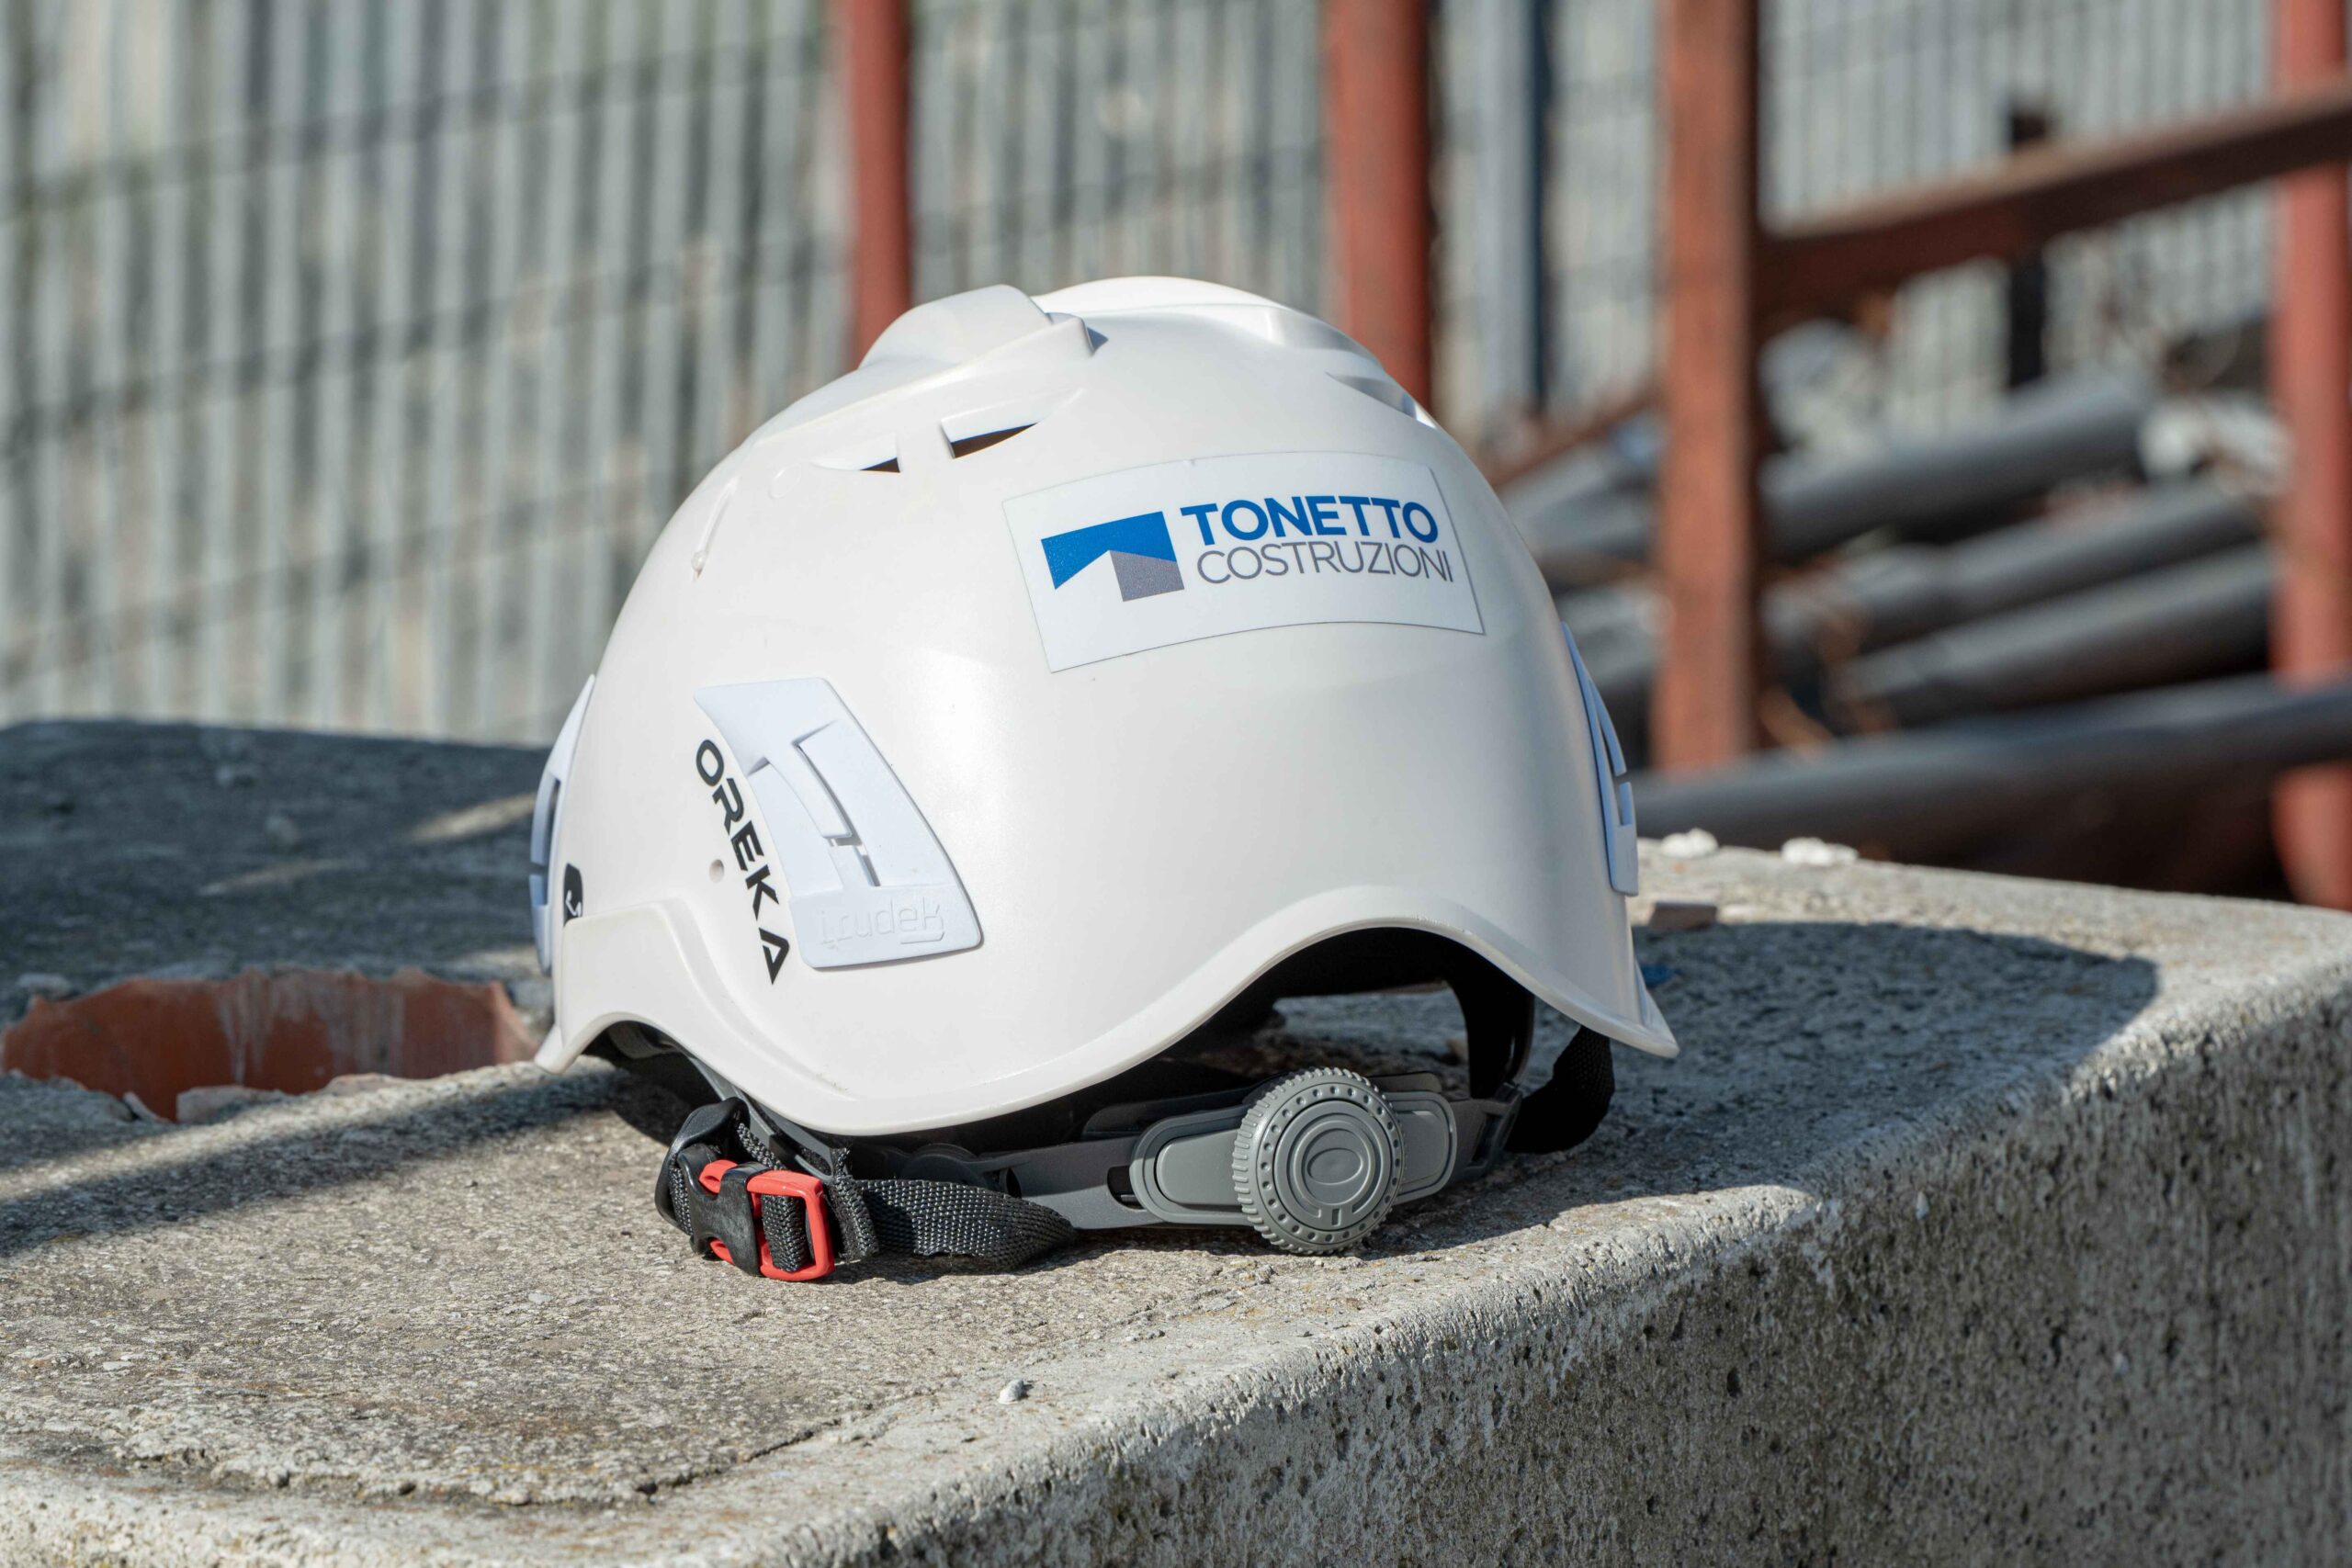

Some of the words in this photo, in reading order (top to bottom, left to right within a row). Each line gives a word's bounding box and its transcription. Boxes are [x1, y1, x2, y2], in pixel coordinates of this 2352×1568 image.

[1180, 495, 1439, 546] TONETTO
[1196, 540, 1453, 584] COSTRUZIONI
[695, 739, 790, 986] OREKA
[819, 897, 945, 945] irudek
